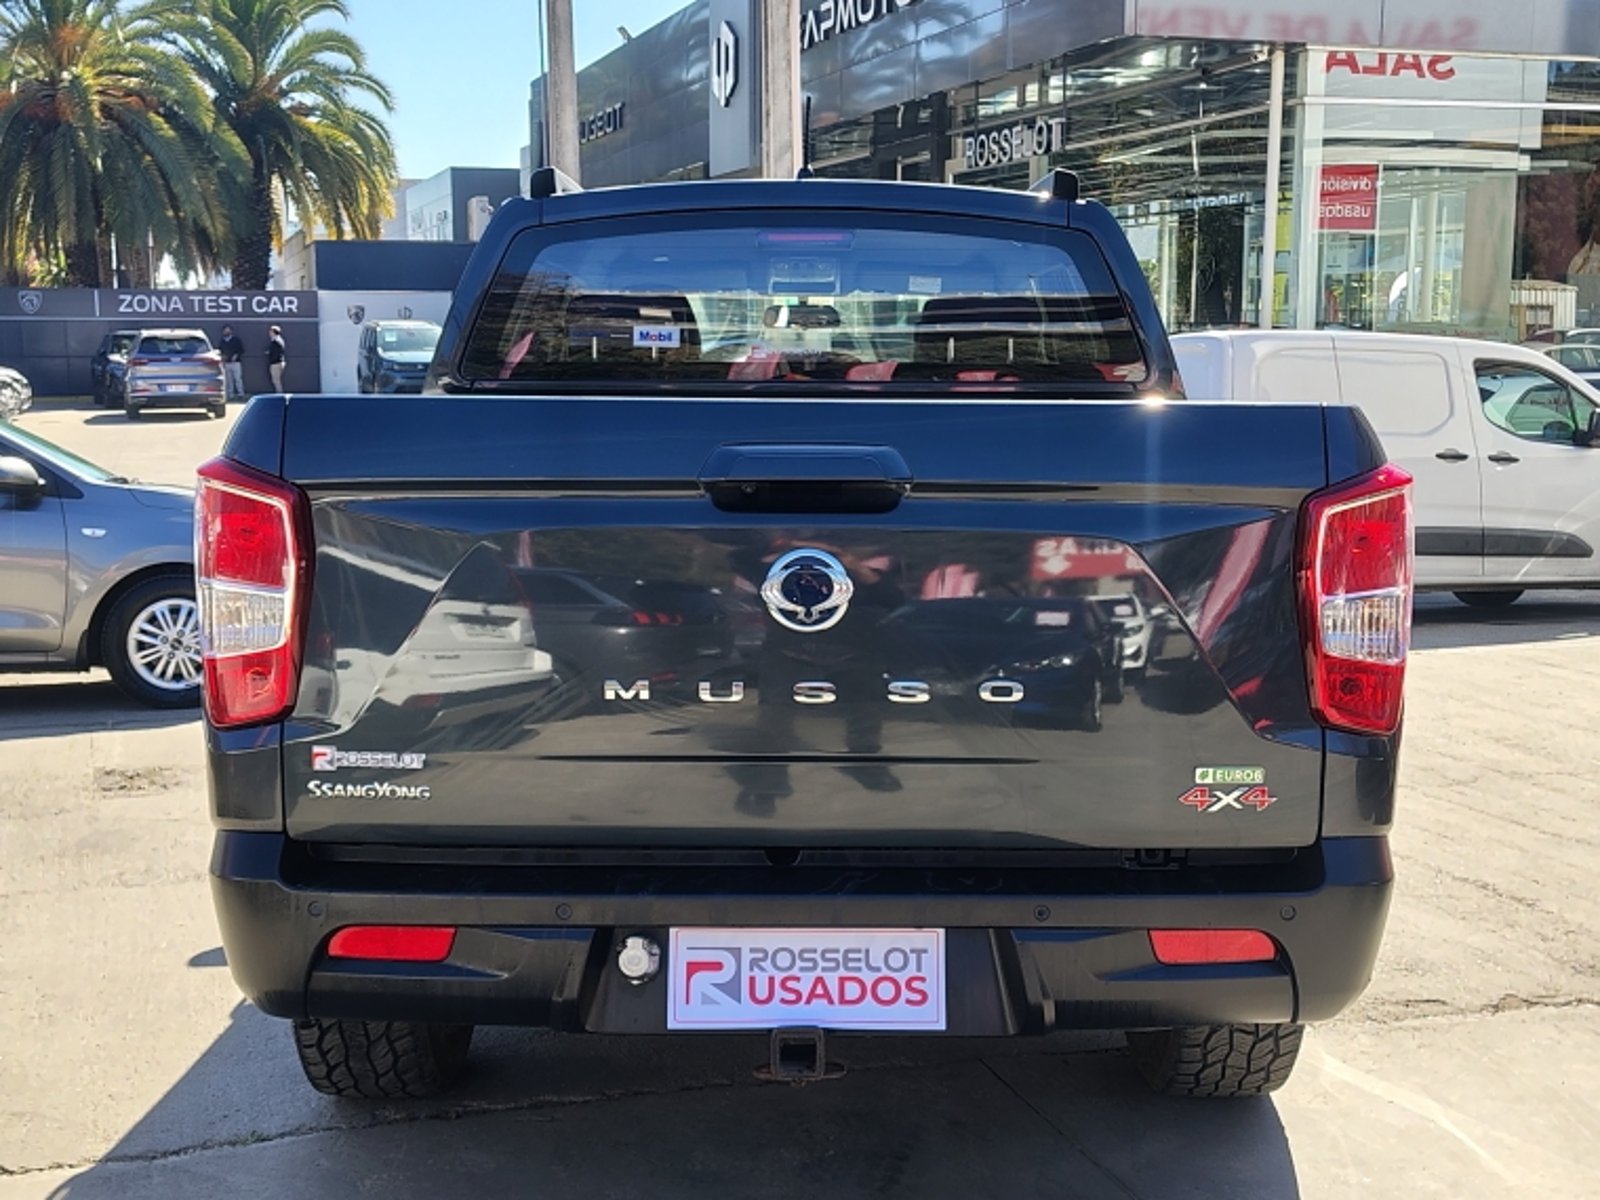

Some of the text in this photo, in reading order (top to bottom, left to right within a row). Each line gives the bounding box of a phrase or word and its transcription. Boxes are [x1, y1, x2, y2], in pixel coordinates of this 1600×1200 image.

[966, 117, 1066, 168] ROSSELOT
[118, 294, 299, 313] ZONA TEST CAR
[640, 330, 673, 342] Mobil
[603, 679, 1025, 704] MUSSO
[337, 751, 426, 769] ROSSELOT
[749, 947, 929, 973] ROSSELOT
[749, 975, 929, 1007] USADOS
